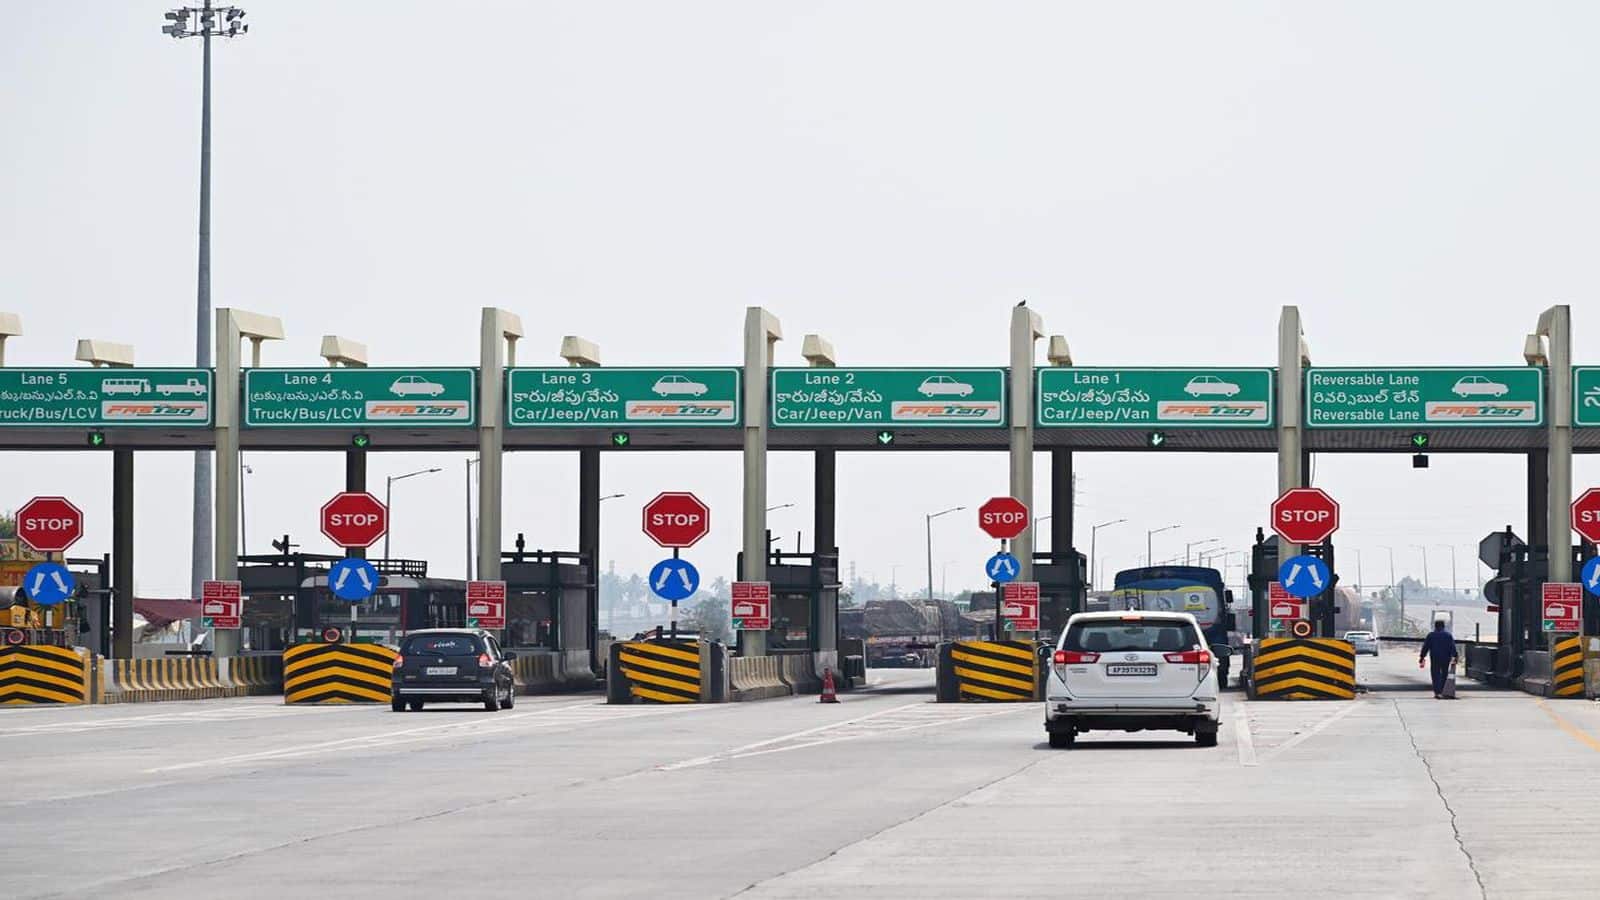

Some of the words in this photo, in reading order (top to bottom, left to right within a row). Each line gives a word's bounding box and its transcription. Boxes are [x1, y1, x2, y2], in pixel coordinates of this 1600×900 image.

[22, 373, 53, 384] Lane
[58, 373, 68, 385] 5
[284, 373, 318, 385] Lane
[322, 373, 332, 385] 4
[543, 373, 576, 384] Lane
[582, 373, 591, 384] 3
[806, 373, 840, 384] Lane
[846, 373, 854, 384] 2
[1074, 373, 1109, 384] Lane
[1115, 373, 1120, 384] 1
[1313, 374, 1384, 385] Reversable
[1390, 374, 1419, 385] Lane
[0, 408, 96, 420] ruck/Bus/LCV
[253, 408, 362, 421] Truck/Bus/LCV
[515, 408, 618, 421] Car/Jeep/Van
[777, 408, 882, 421] Car/Jeep/Van
[1044, 408, 1149, 421] Car/Jeep/Van
[1314, 409, 1384, 420] Reversable
[1390, 409, 1419, 420] Lane
[331, 514, 378, 526] STOP
[653, 514, 699, 525] STOP
[984, 512, 1024, 524] STOP
[1282, 510, 1329, 522] STOP
[1582, 511, 1600, 522] ST
[26, 519, 73, 530] STOP
